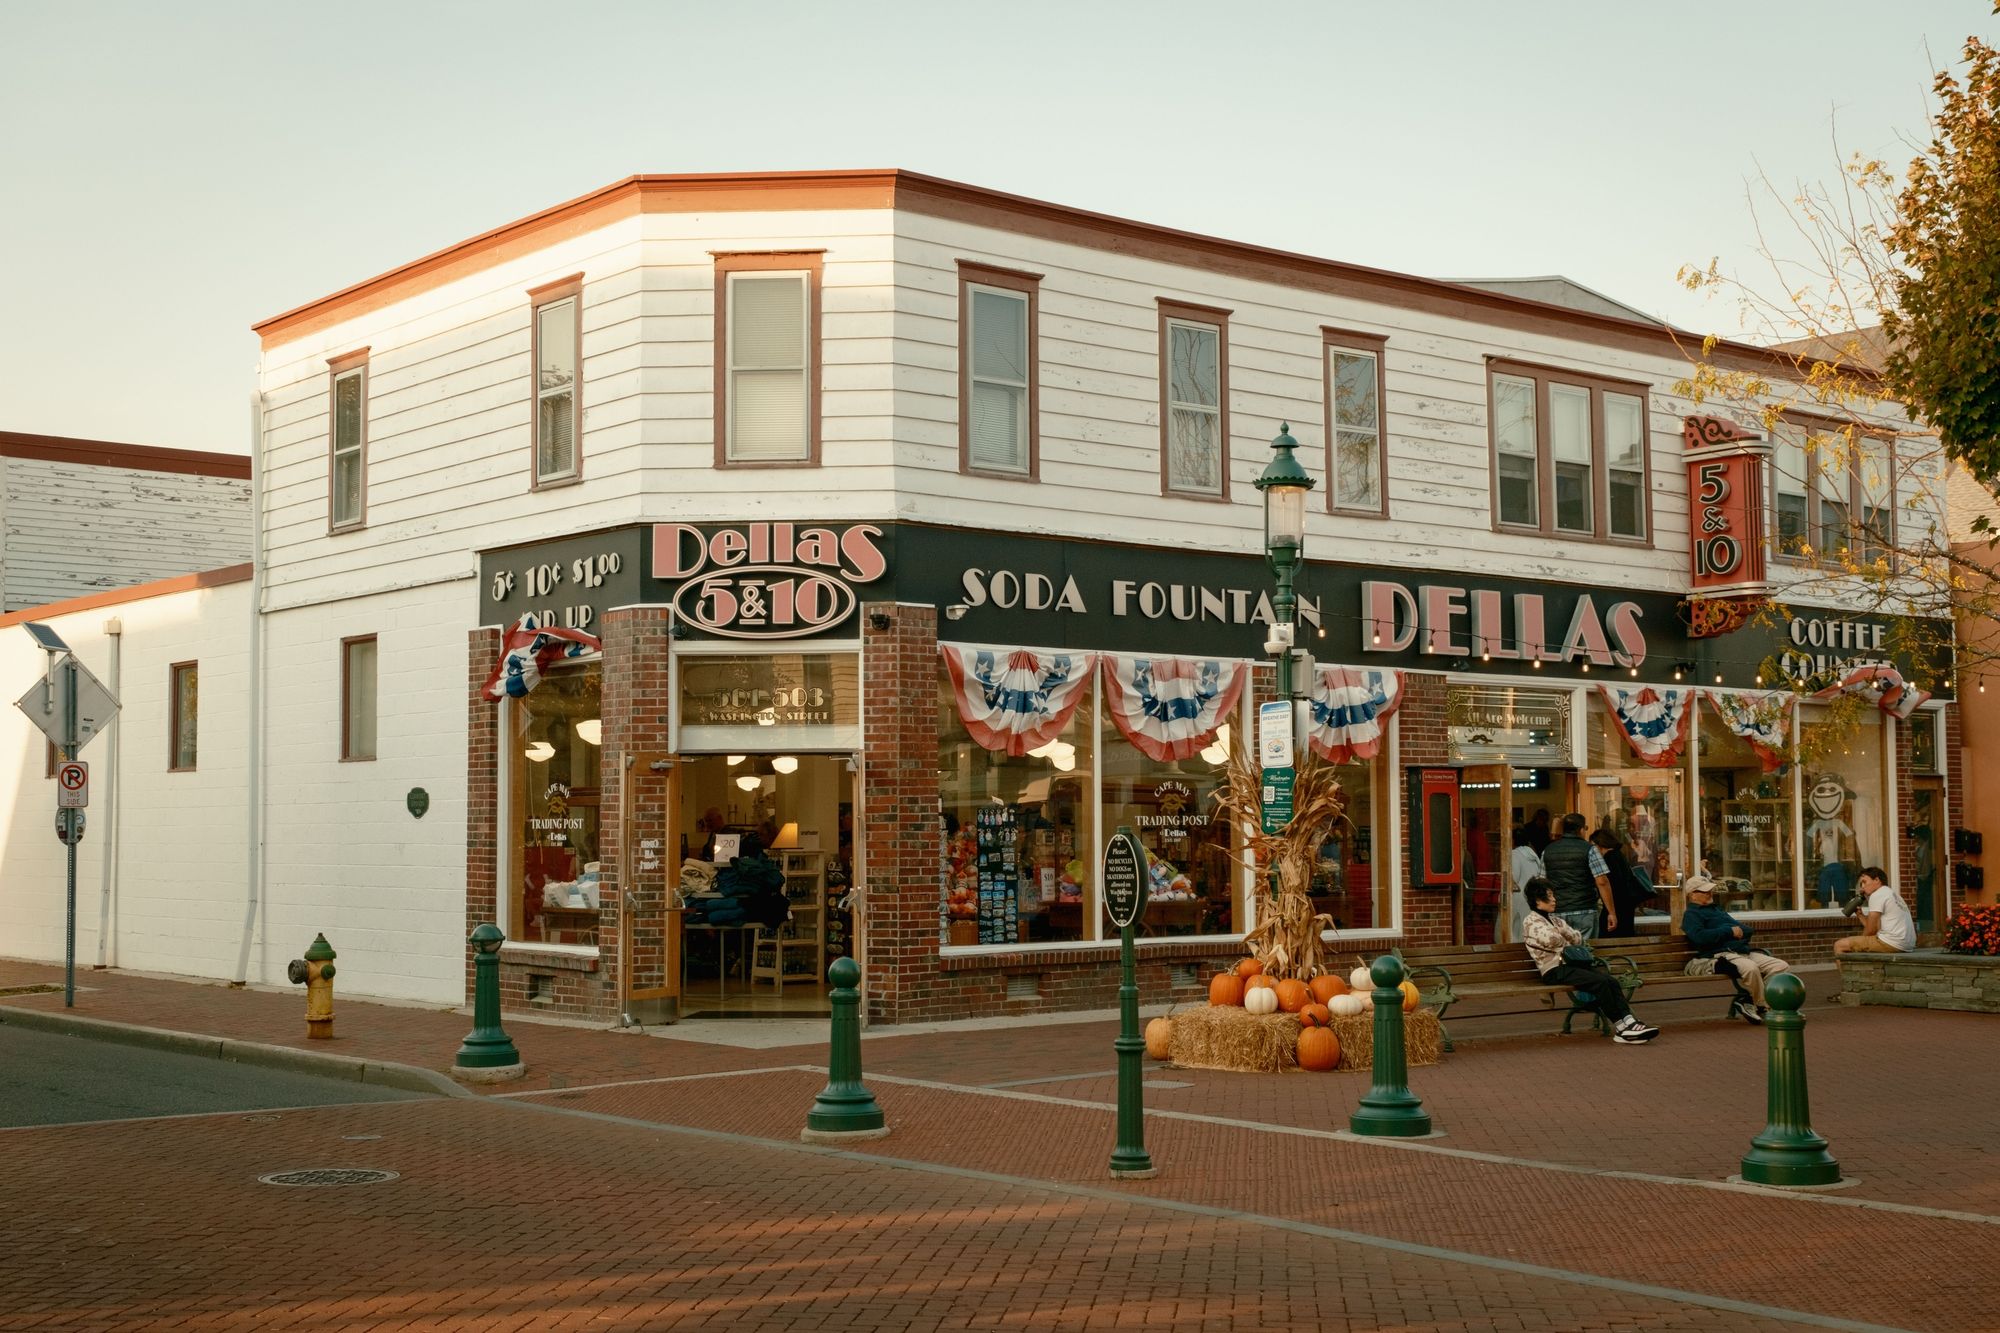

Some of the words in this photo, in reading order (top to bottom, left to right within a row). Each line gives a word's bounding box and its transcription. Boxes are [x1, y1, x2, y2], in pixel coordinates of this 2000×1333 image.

[1699, 463, 1730, 504] 5
[1701, 506, 1729, 533] &
[1696, 534, 1742, 576] 10
[525, 562, 561, 597] 10¢
[962, 568, 1087, 613] SODA
[1112, 579, 1321, 628] FOUNTAN
[522, 609, 556, 628] ND
[566, 604, 592, 628] UP
[1361, 580, 1647, 669] DELLAS
[1790, 617, 1886, 651] COFFEE
[786, 711, 829, 721] STREET
[1484, 713, 1503, 724] Are
[1505, 713, 1552, 726] Welcome
[544, 783, 559, 800] CAPE
[1154, 781, 1174, 797] CAPE
[1175, 781, 1192, 797] MAY
[530, 818, 562, 830] TRADING
[563, 818, 584, 830] POST
[1135, 815, 1180, 826] TRADING
[1182, 815, 1209, 826] POST
[1723, 815, 1753, 824] TRADING
[1753, 815, 1772, 824] POST
[1164, 828, 1187, 837] Dellas
